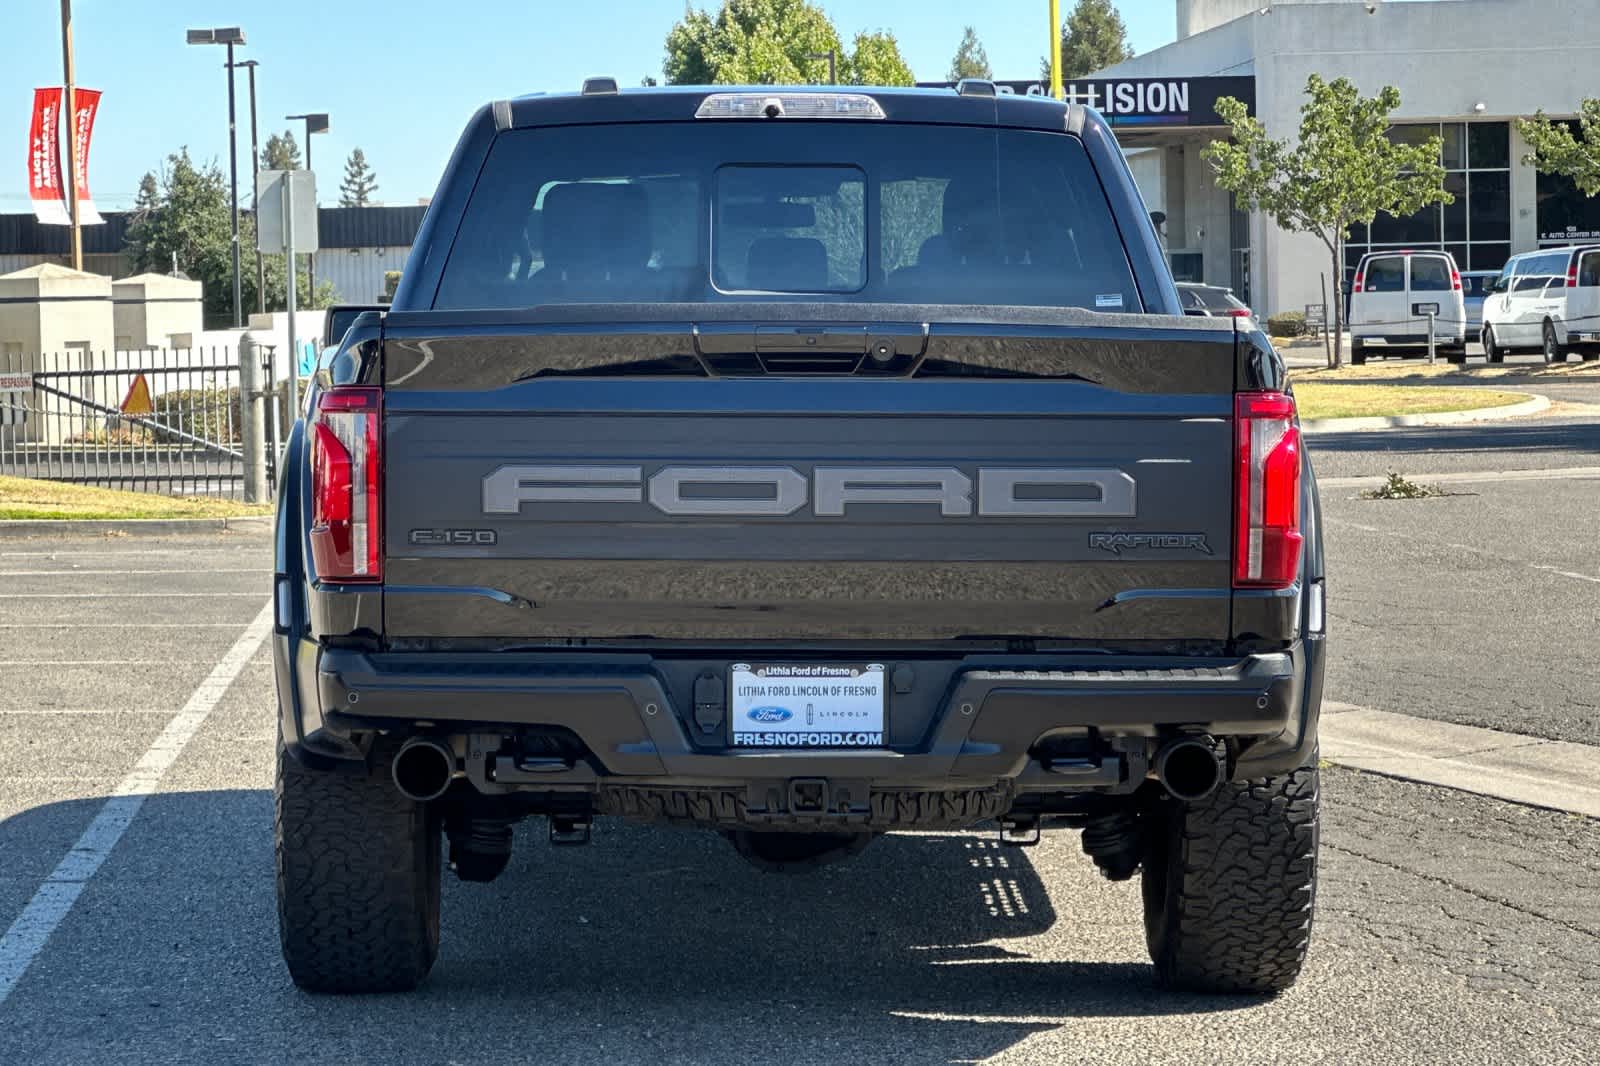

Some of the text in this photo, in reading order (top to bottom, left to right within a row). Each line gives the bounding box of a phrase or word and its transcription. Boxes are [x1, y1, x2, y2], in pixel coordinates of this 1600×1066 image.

[1026, 82, 1189, 114] LLISION
[481, 464, 1137, 518] FORD
[410, 529, 497, 544] F-150
[1088, 532, 1212, 554] RAPTOR
[766, 666, 850, 676] Lithia Ford of Fresno
[738, 686, 877, 697] LITHIA FORD LINCOLN OF FRESNO
[755, 708, 784, 721] Ford
[733, 733, 882, 745] FRESNOFORD.COM
